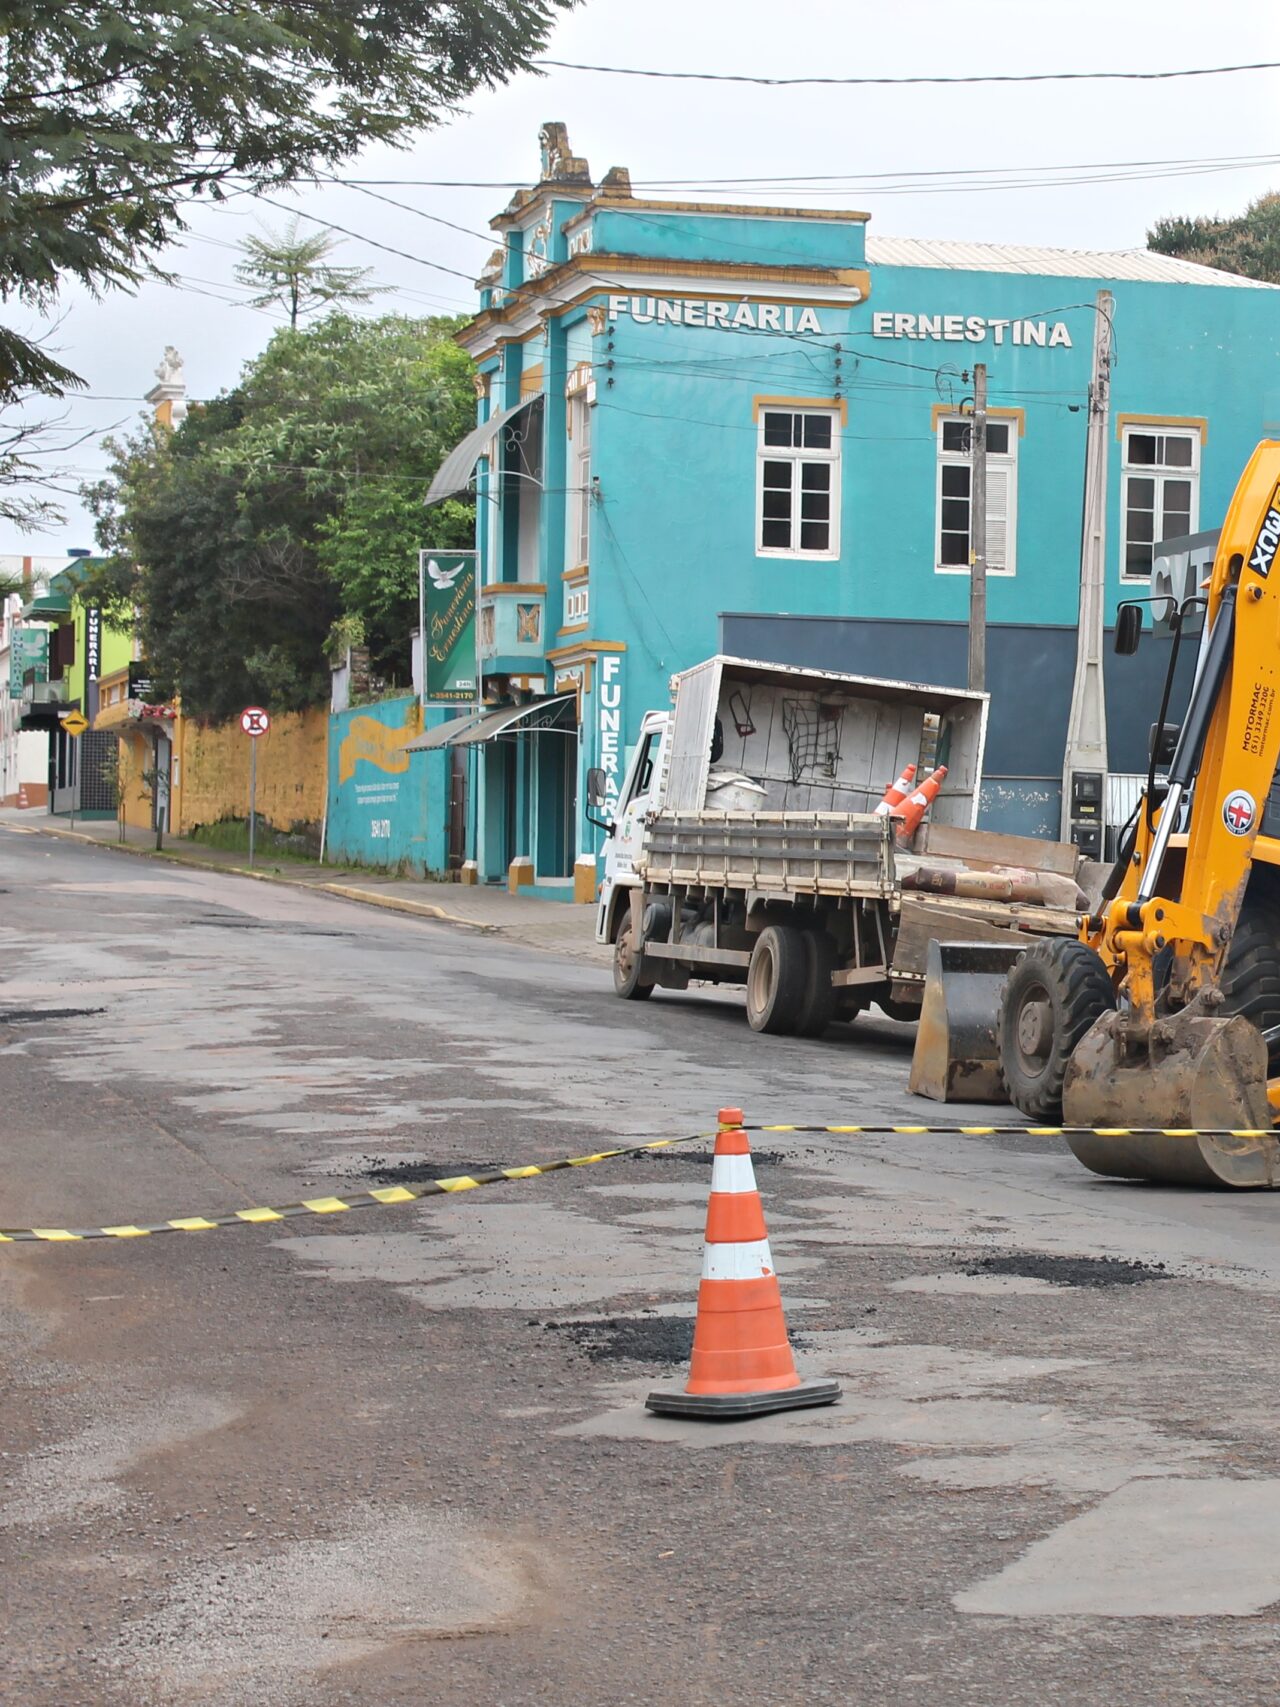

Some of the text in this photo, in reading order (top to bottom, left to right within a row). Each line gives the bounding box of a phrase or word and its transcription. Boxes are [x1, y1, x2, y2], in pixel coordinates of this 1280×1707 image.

[608, 295, 1073, 349] FUNERÁRIA ERNESTINA
[1242, 683, 1261, 751] MOTORMAC
